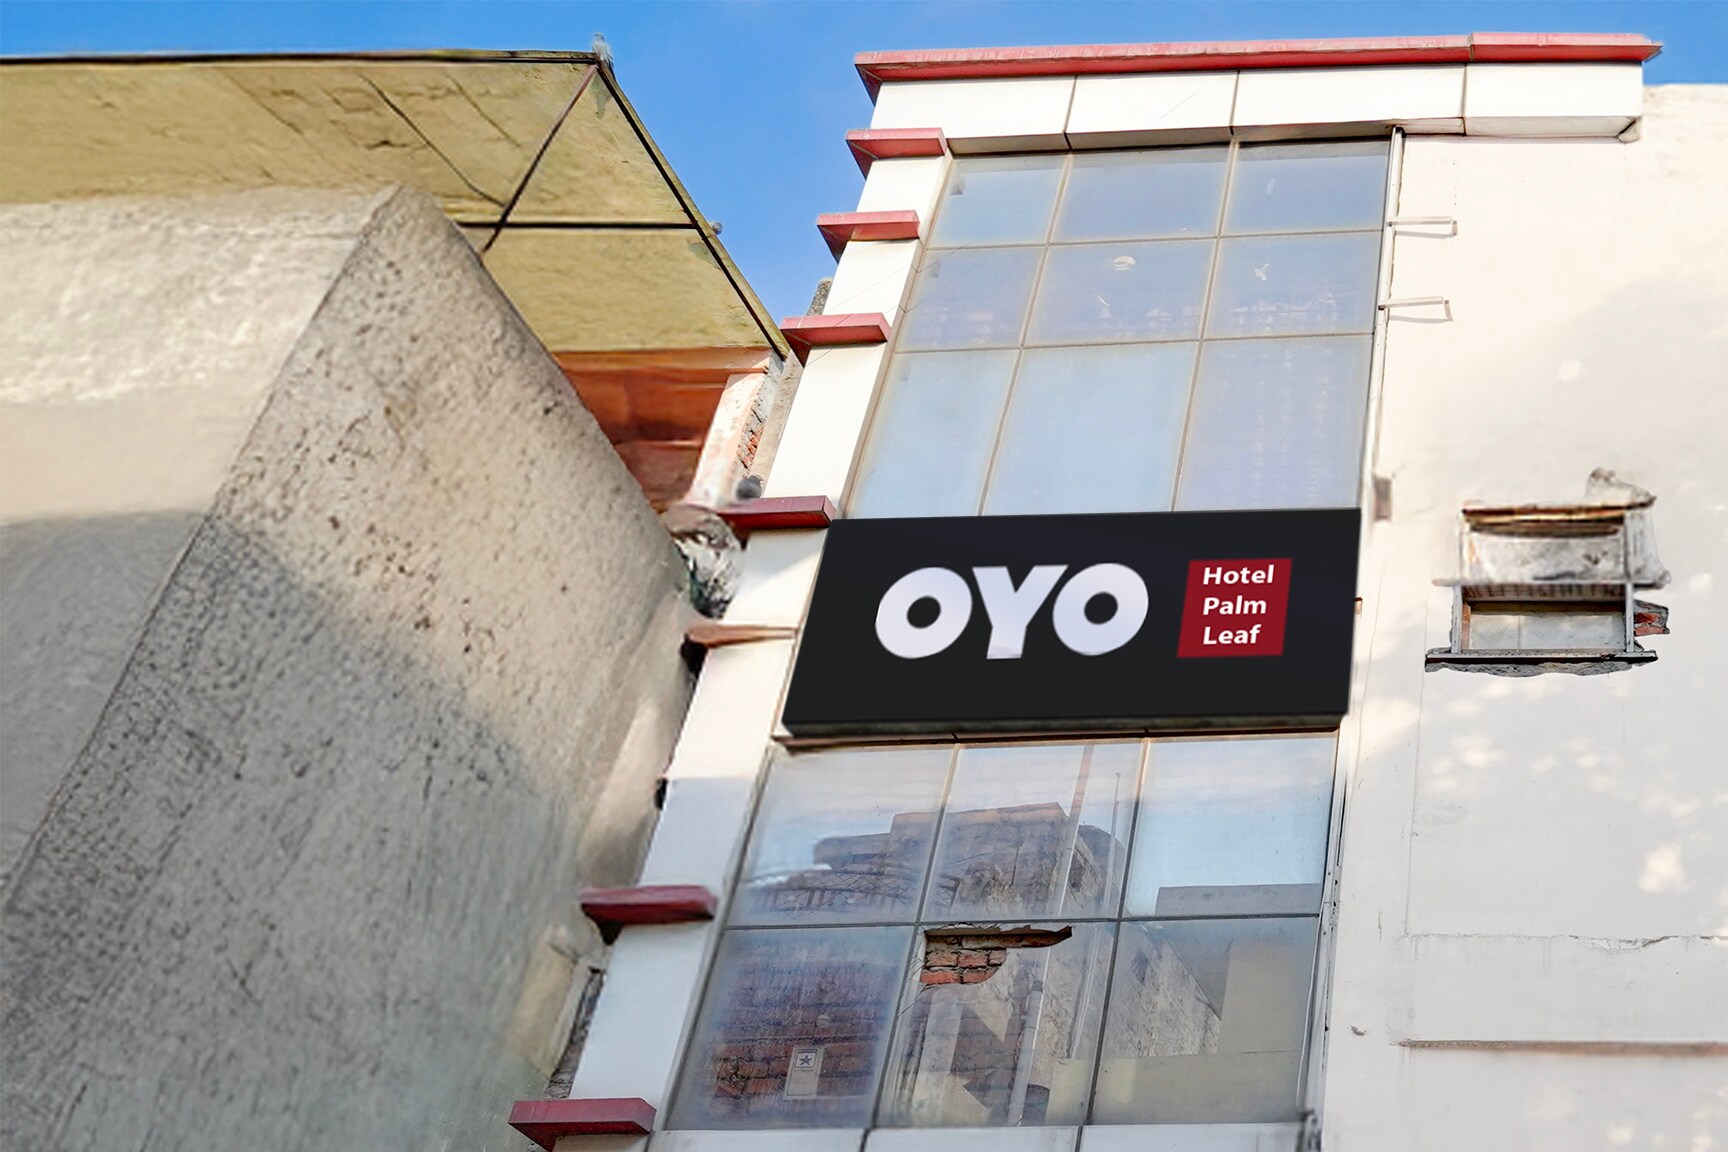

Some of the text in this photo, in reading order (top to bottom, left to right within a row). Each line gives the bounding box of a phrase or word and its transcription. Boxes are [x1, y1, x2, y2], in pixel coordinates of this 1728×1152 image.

[1204, 565, 1274, 584] Hotel
[876, 563, 1148, 659] OYO
[1204, 596, 1266, 615] Palm
[1204, 624, 1261, 644] Leaf
